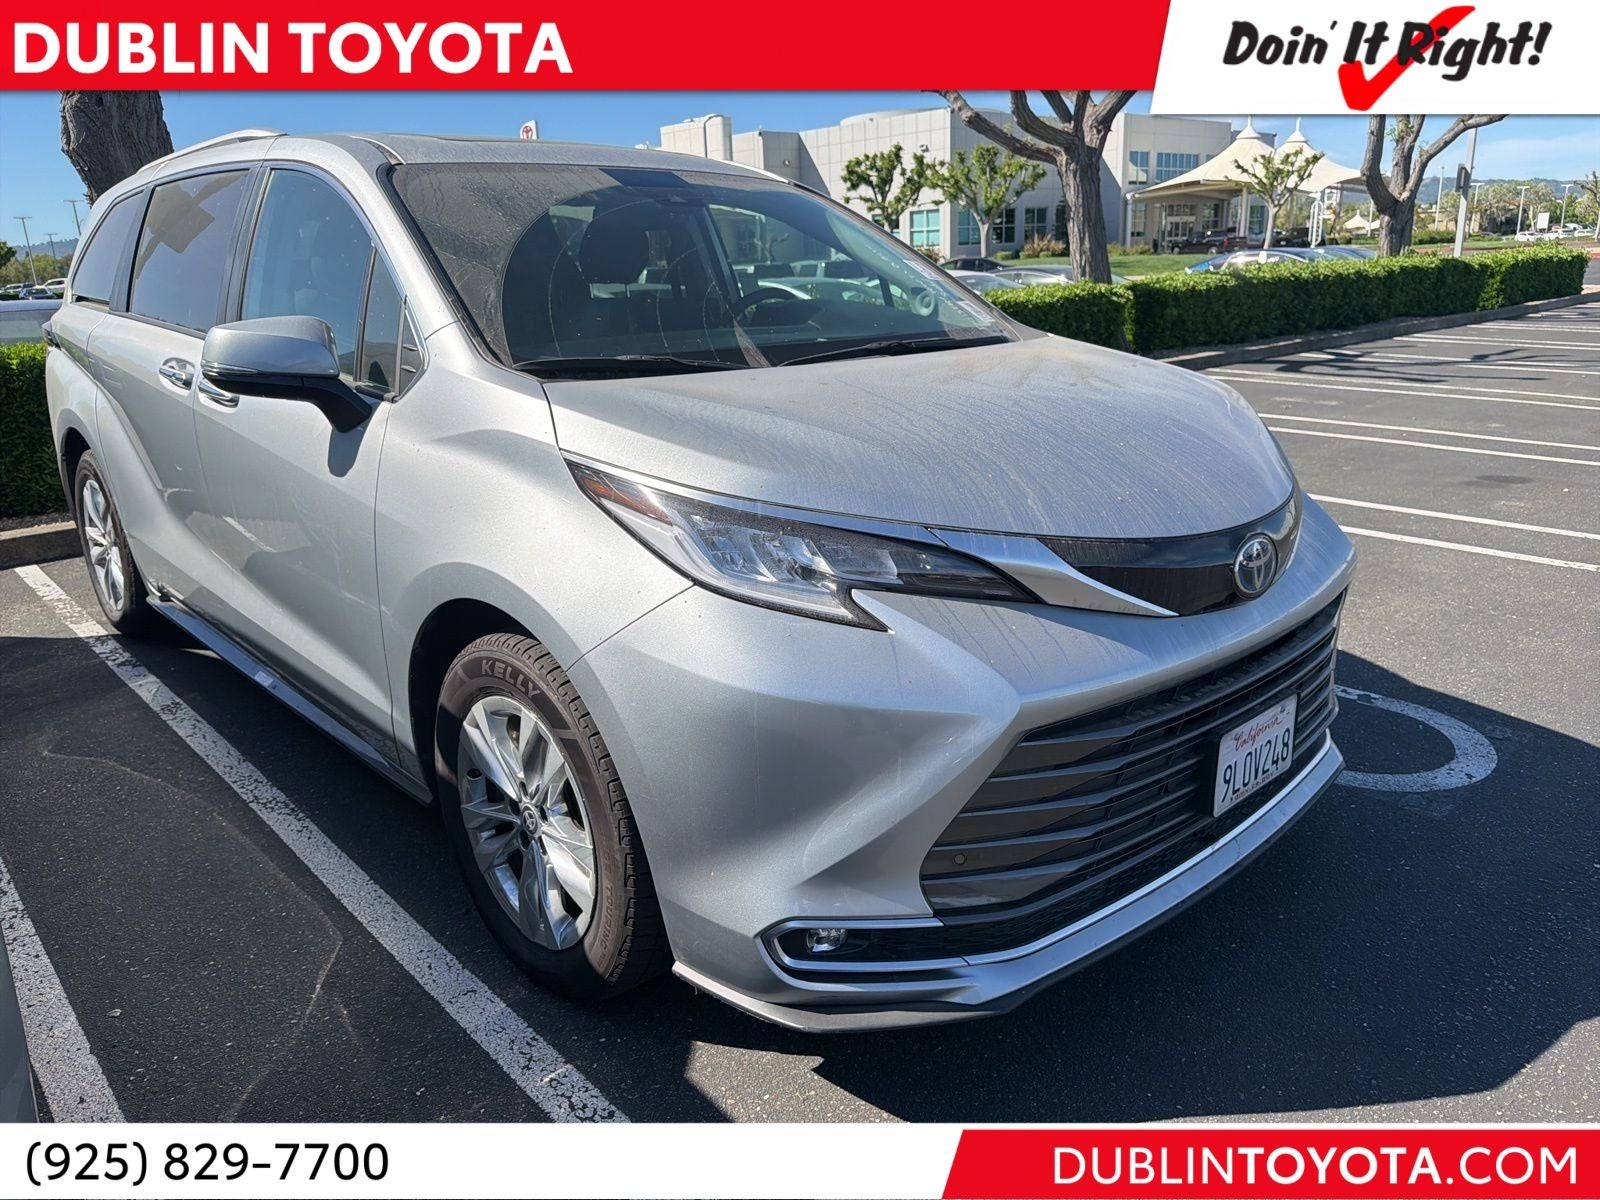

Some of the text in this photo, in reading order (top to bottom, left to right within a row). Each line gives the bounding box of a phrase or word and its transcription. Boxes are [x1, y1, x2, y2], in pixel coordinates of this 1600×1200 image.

[481, 659, 541, 698] KELLY
[1233, 717, 1282, 751] California
[1221, 726, 1291, 803] 9LOV248
